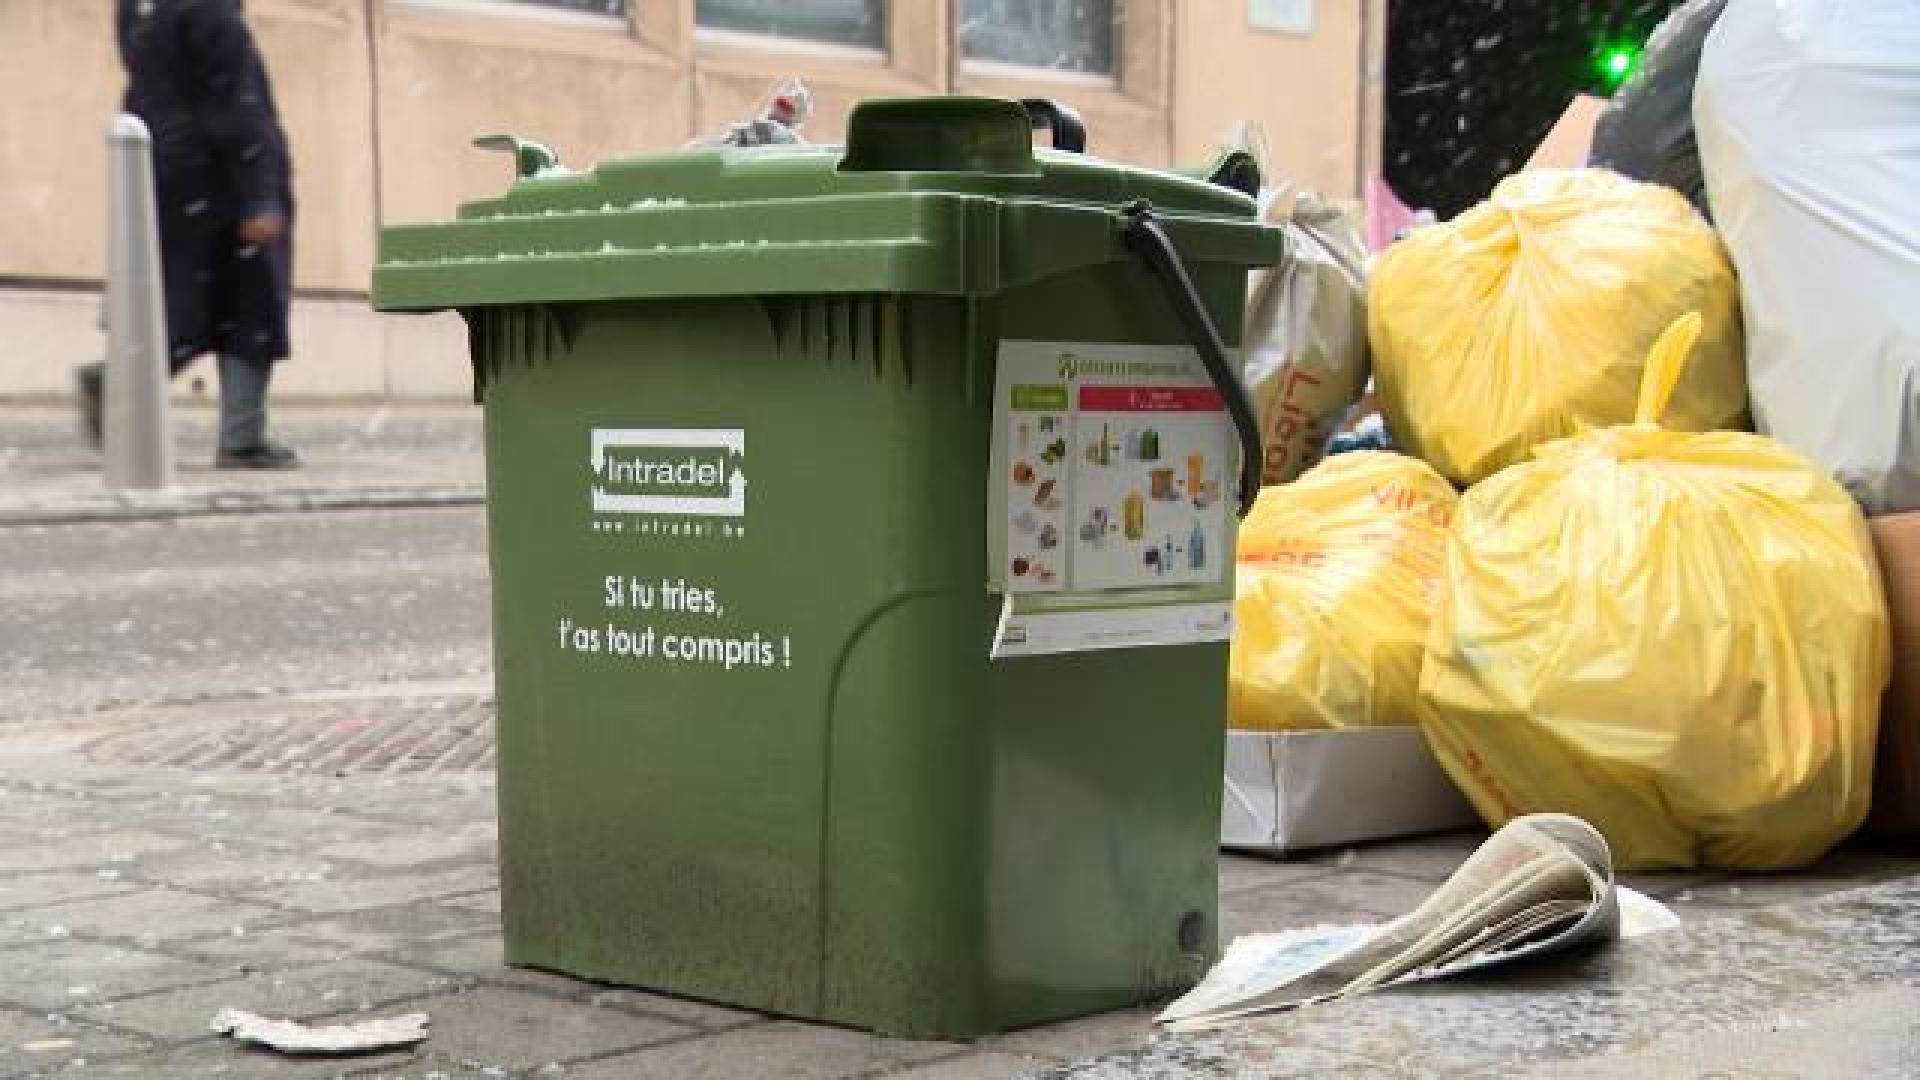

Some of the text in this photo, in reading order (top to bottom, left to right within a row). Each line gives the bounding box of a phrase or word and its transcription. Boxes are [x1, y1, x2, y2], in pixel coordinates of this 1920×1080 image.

[608, 456, 725, 487] Intradel
[605, 576, 724, 619] Si tu tries,
[559, 617, 792, 670] t'as tout compris !
